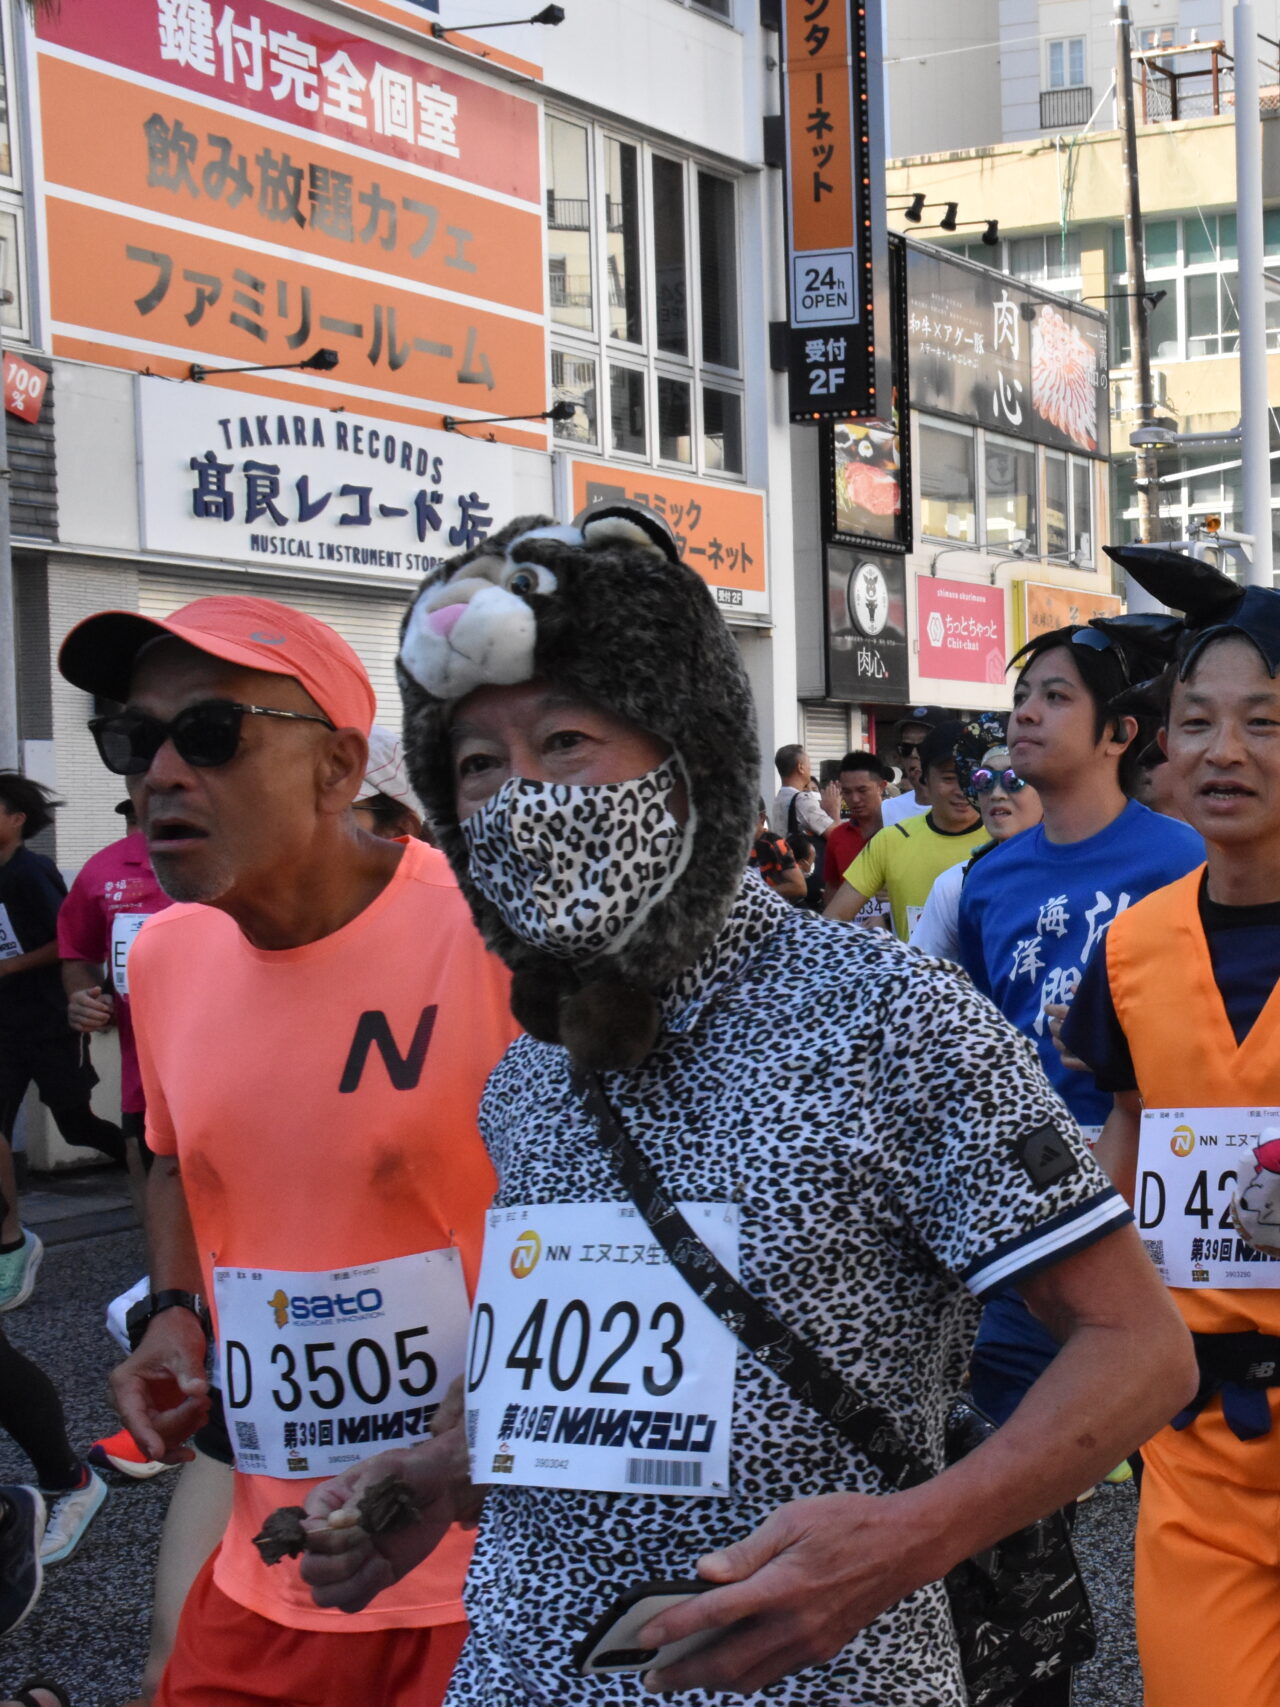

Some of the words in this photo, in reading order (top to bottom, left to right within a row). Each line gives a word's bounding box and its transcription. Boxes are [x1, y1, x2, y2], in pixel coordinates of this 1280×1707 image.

[158, 0, 462, 159] 鍵付完全個室
[802, 0, 835, 203] ンターネット
[143, 112, 478, 274] 飲み放題カフェ
[804, 267, 845, 293] 24h
[125, 244, 497, 391] ファミリールーム
[802, 293, 848, 310] OPEN
[805, 337, 847, 363] 受付
[992, 289, 1023, 426] 肉心
[6, 363, 42, 398] 100
[809, 367, 846, 395] 2F
[11, 390, 26, 411] %
[218, 415, 325, 450] TAKARA
[335, 420, 443, 485] RECORDS
[250, 533, 314, 559] MUSICAL
[318, 541, 402, 570] INSTRUMENT
[673, 532, 754, 574] ターネット
[732, 591, 742, 604] 2F
[945, 614, 998, 639] ちっとちゃっと
[947, 637, 979, 651] Chit-chat
[857, 647, 886, 679] 肉心
[115, 941, 127, 967] E
[1200, 1135, 1218, 1146] NN
[1139, 1171, 1166, 1230] D
[1184, 1170, 1239, 1230] 42
[545, 1245, 572, 1262] NN
[291, 1288, 384, 1320] sato
[468, 1303, 495, 1393] D
[504, 1298, 685, 1397] 4023
[226, 1340, 252, 1409] D
[270, 1325, 438, 1412] 3505
